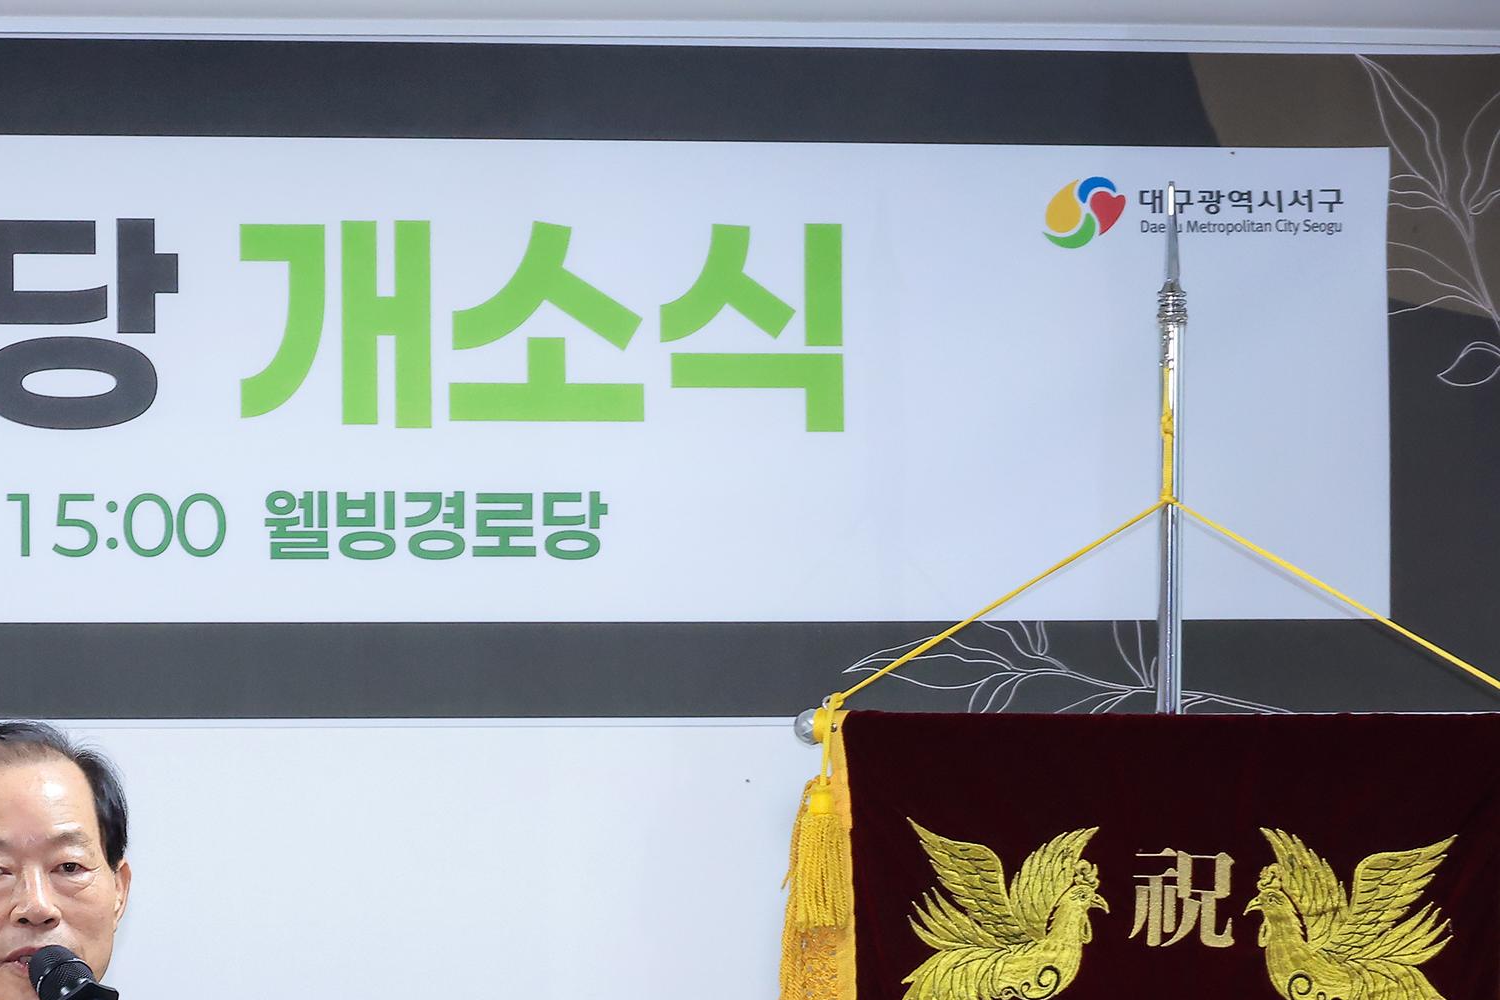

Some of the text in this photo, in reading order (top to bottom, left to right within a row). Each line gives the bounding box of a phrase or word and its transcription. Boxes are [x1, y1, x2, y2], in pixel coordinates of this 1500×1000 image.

[1139, 189, 1344, 215] 대구광역시서구
[1140, 218, 1343, 236] Daeu Metropolitan City Seogu
[240, 220, 845, 433] 개소식
[6, 492, 227, 558] 15:00
[264, 490, 609, 561] 웰빙경로당
[1128, 847, 1236, 948] 祝
